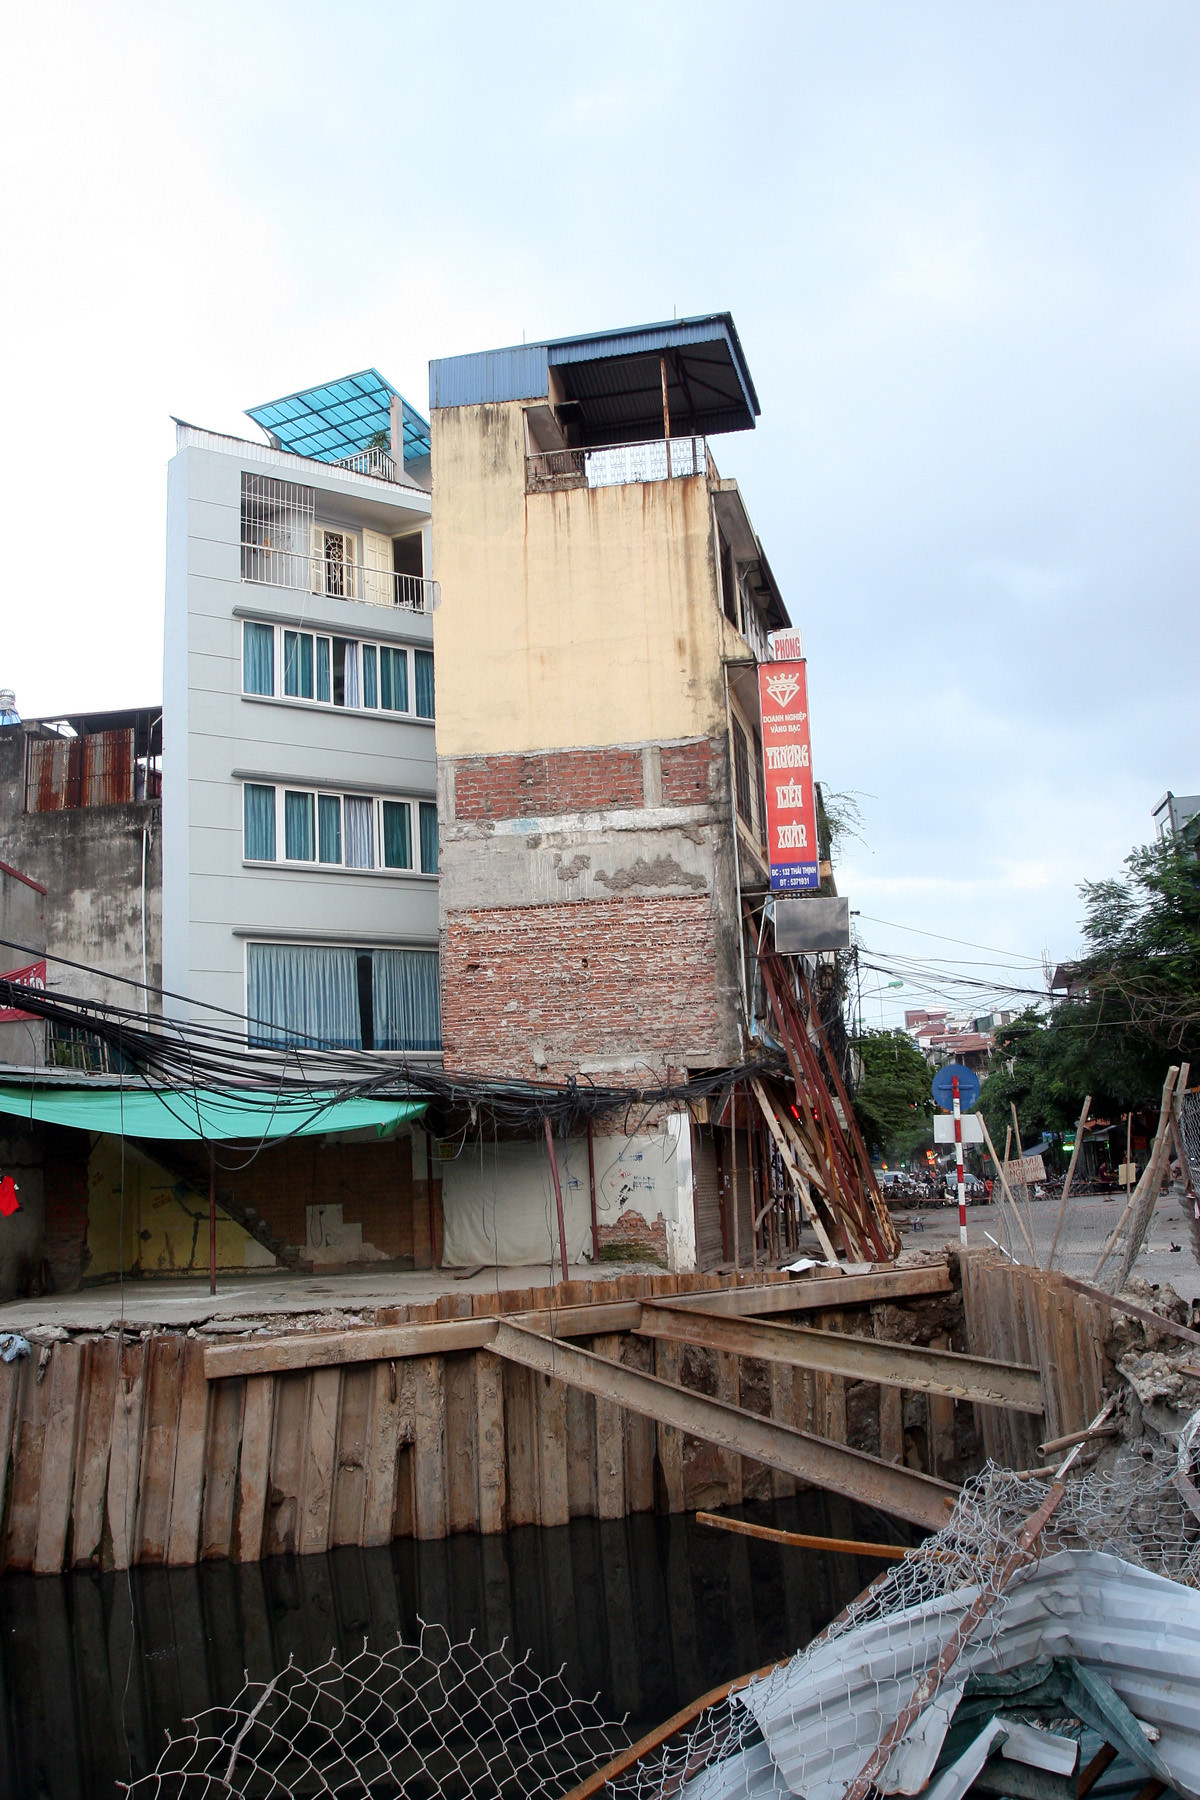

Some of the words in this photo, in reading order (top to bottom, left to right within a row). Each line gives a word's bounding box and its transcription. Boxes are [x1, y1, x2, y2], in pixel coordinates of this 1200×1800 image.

[763, 714, 784, 723] DOANH
[785, 711, 807, 722] NGHIỆP
[770, 723, 787, 733] VÀNG
[788, 724, 801, 734] BẠC
[777, 819, 807, 849] XUÂN
[782, 868, 790, 876] 132
[790, 866, 802, 875] THÁI
[802, 866, 816, 875] THỊNH
